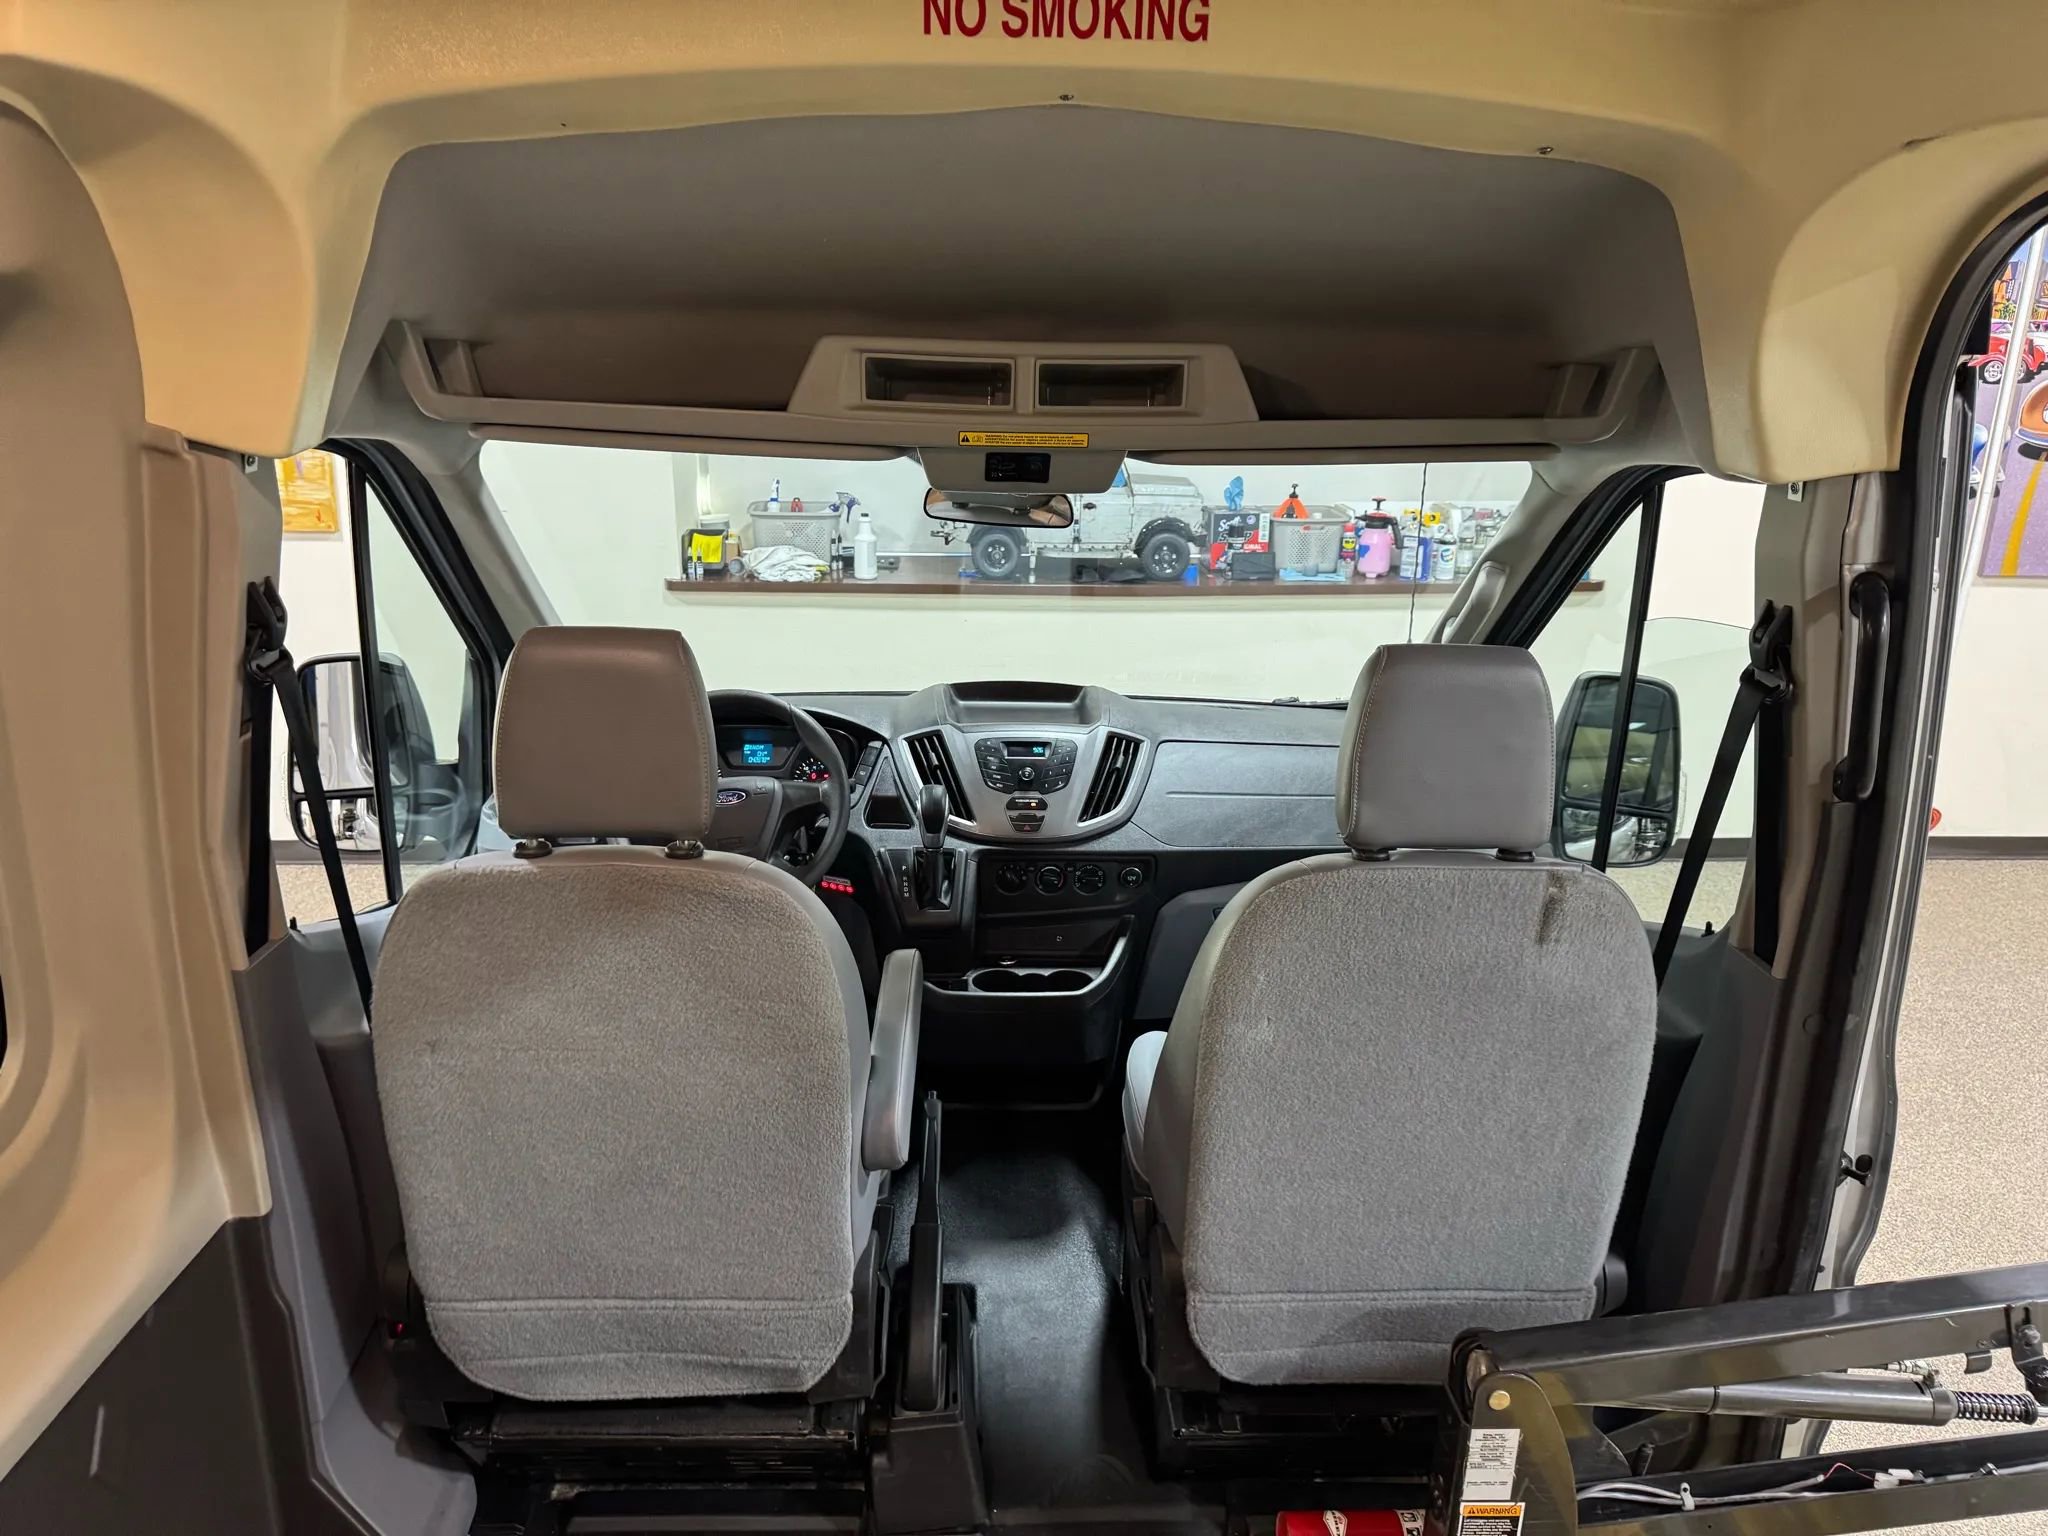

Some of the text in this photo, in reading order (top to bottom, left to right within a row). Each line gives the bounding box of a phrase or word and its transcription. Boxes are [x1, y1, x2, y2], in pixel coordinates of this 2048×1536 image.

[923, 0, 1210, 42] NO SMOKING
[1217, 530, 1254, 543] SP
[1476, 1507, 1517, 1515] WARNING
